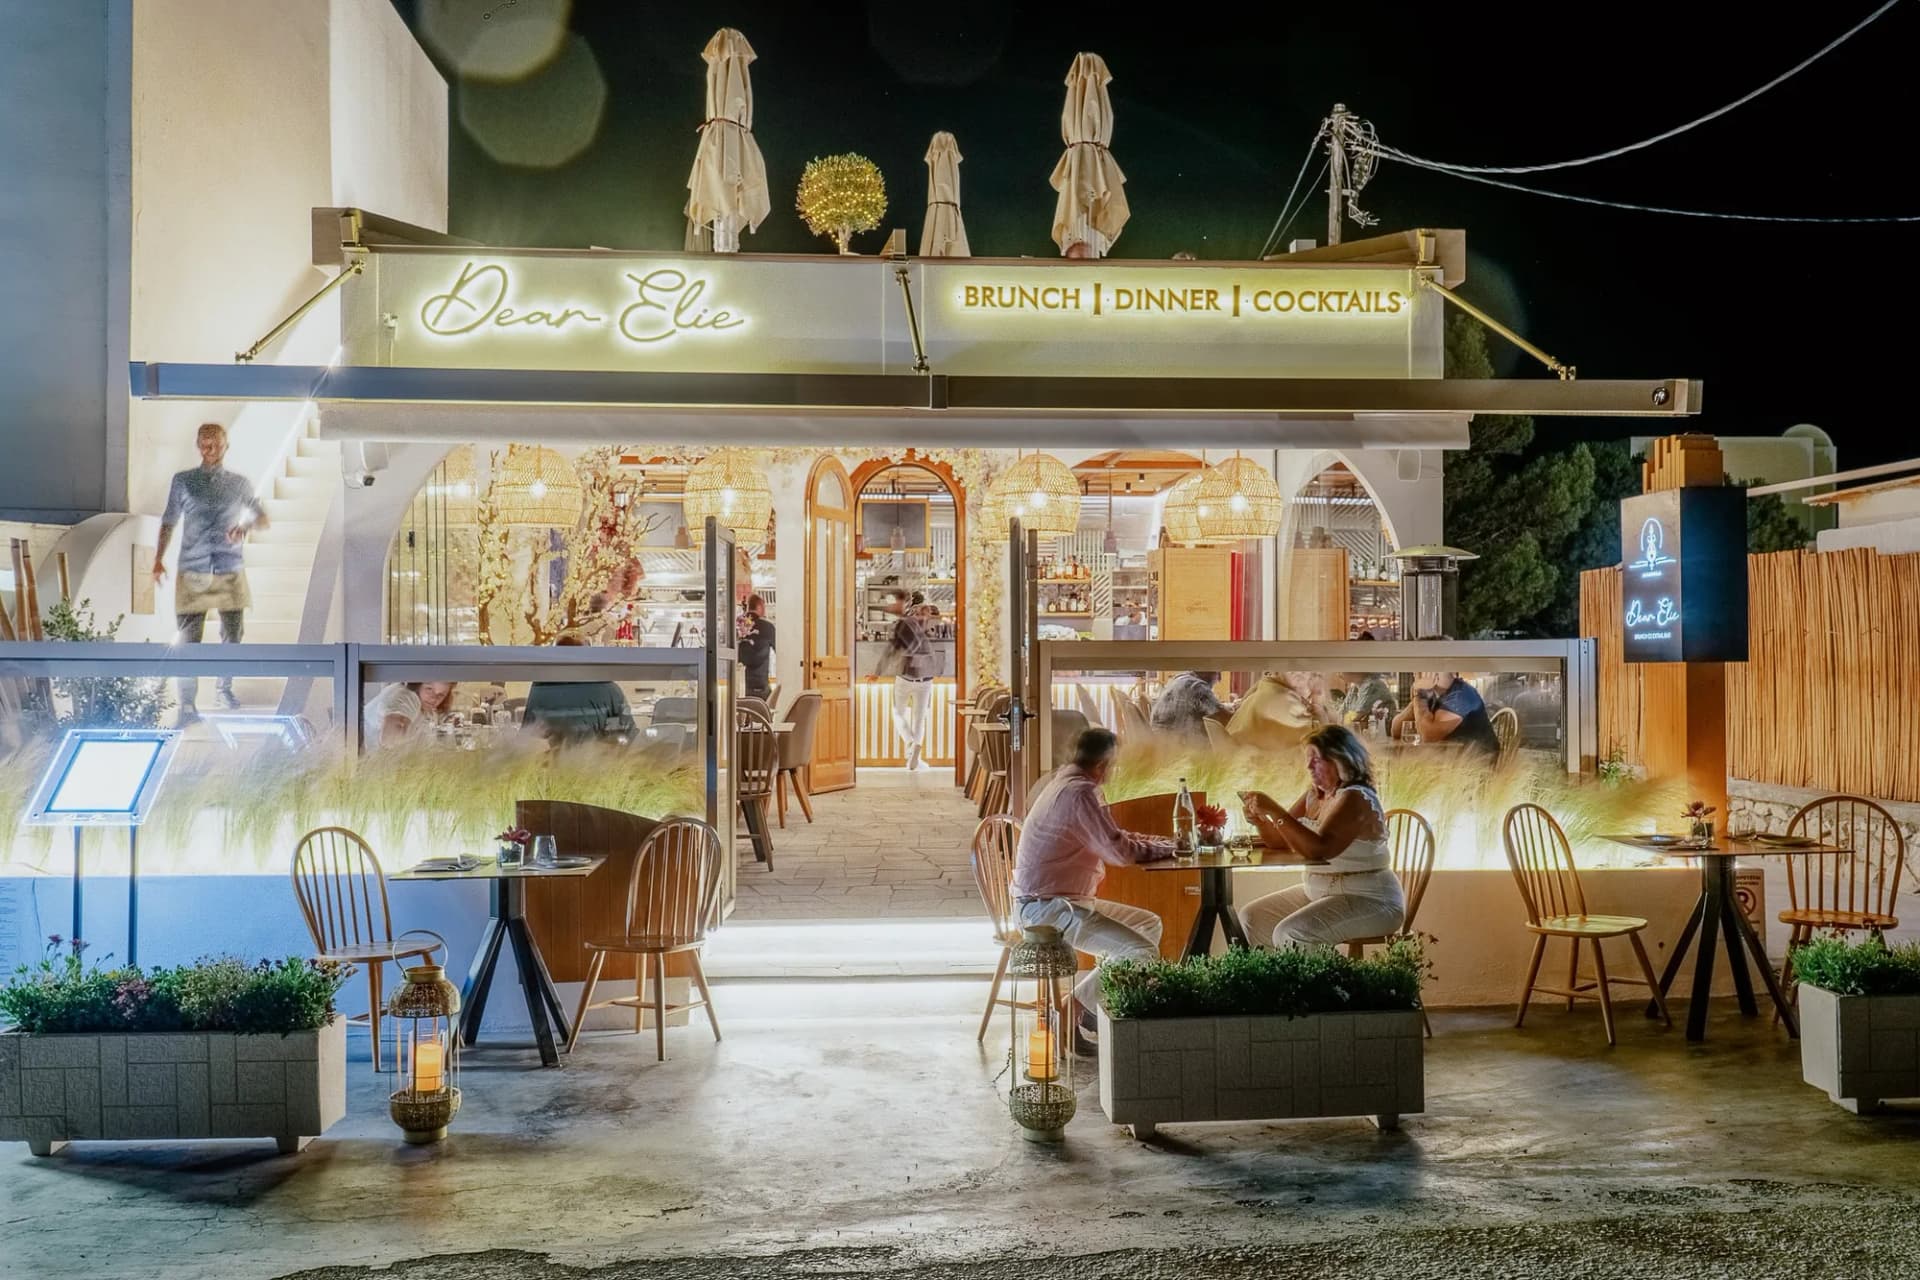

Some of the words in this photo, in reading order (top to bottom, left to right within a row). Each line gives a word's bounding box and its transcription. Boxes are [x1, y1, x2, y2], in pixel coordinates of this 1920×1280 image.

[420, 261, 601, 336] Dear
[618, 269, 745, 342] Elie
[963, 284, 1081, 310] BRUNCH
[1114, 287, 1222, 313] DINNER
[1252, 289, 1402, 314] COCKTAILS
